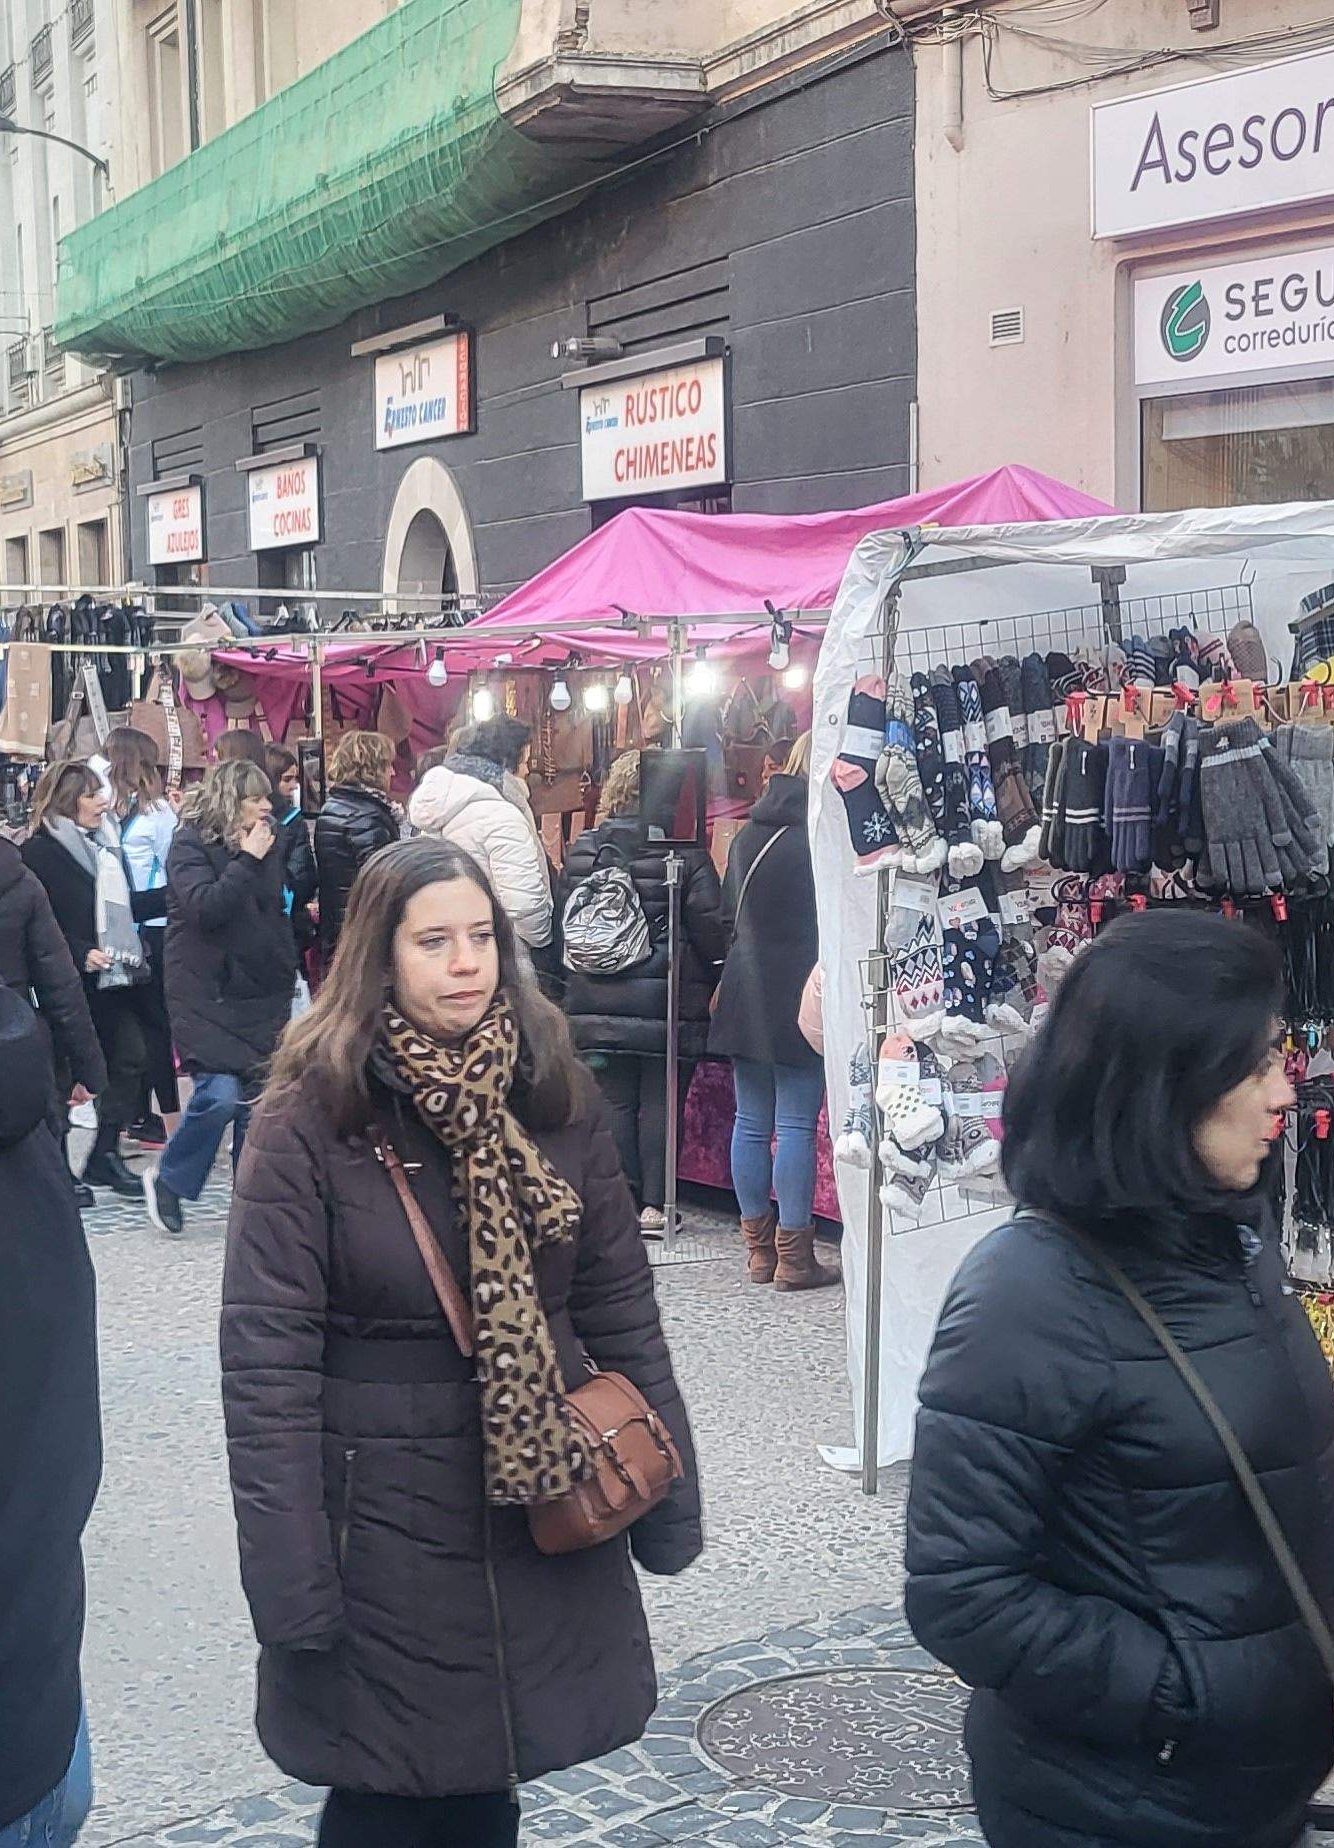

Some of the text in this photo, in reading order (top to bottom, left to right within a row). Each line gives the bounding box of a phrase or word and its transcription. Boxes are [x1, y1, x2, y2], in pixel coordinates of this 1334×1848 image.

[625, 379, 702, 428] RÚSTICO
[614, 433, 717, 482] CHIMENEAS
[276, 467, 306, 500] BAÑOS
[172, 497, 190, 520] GRES
[273, 507, 312, 538] COCINAS
[166, 527, 199, 556] AZULEJOS
